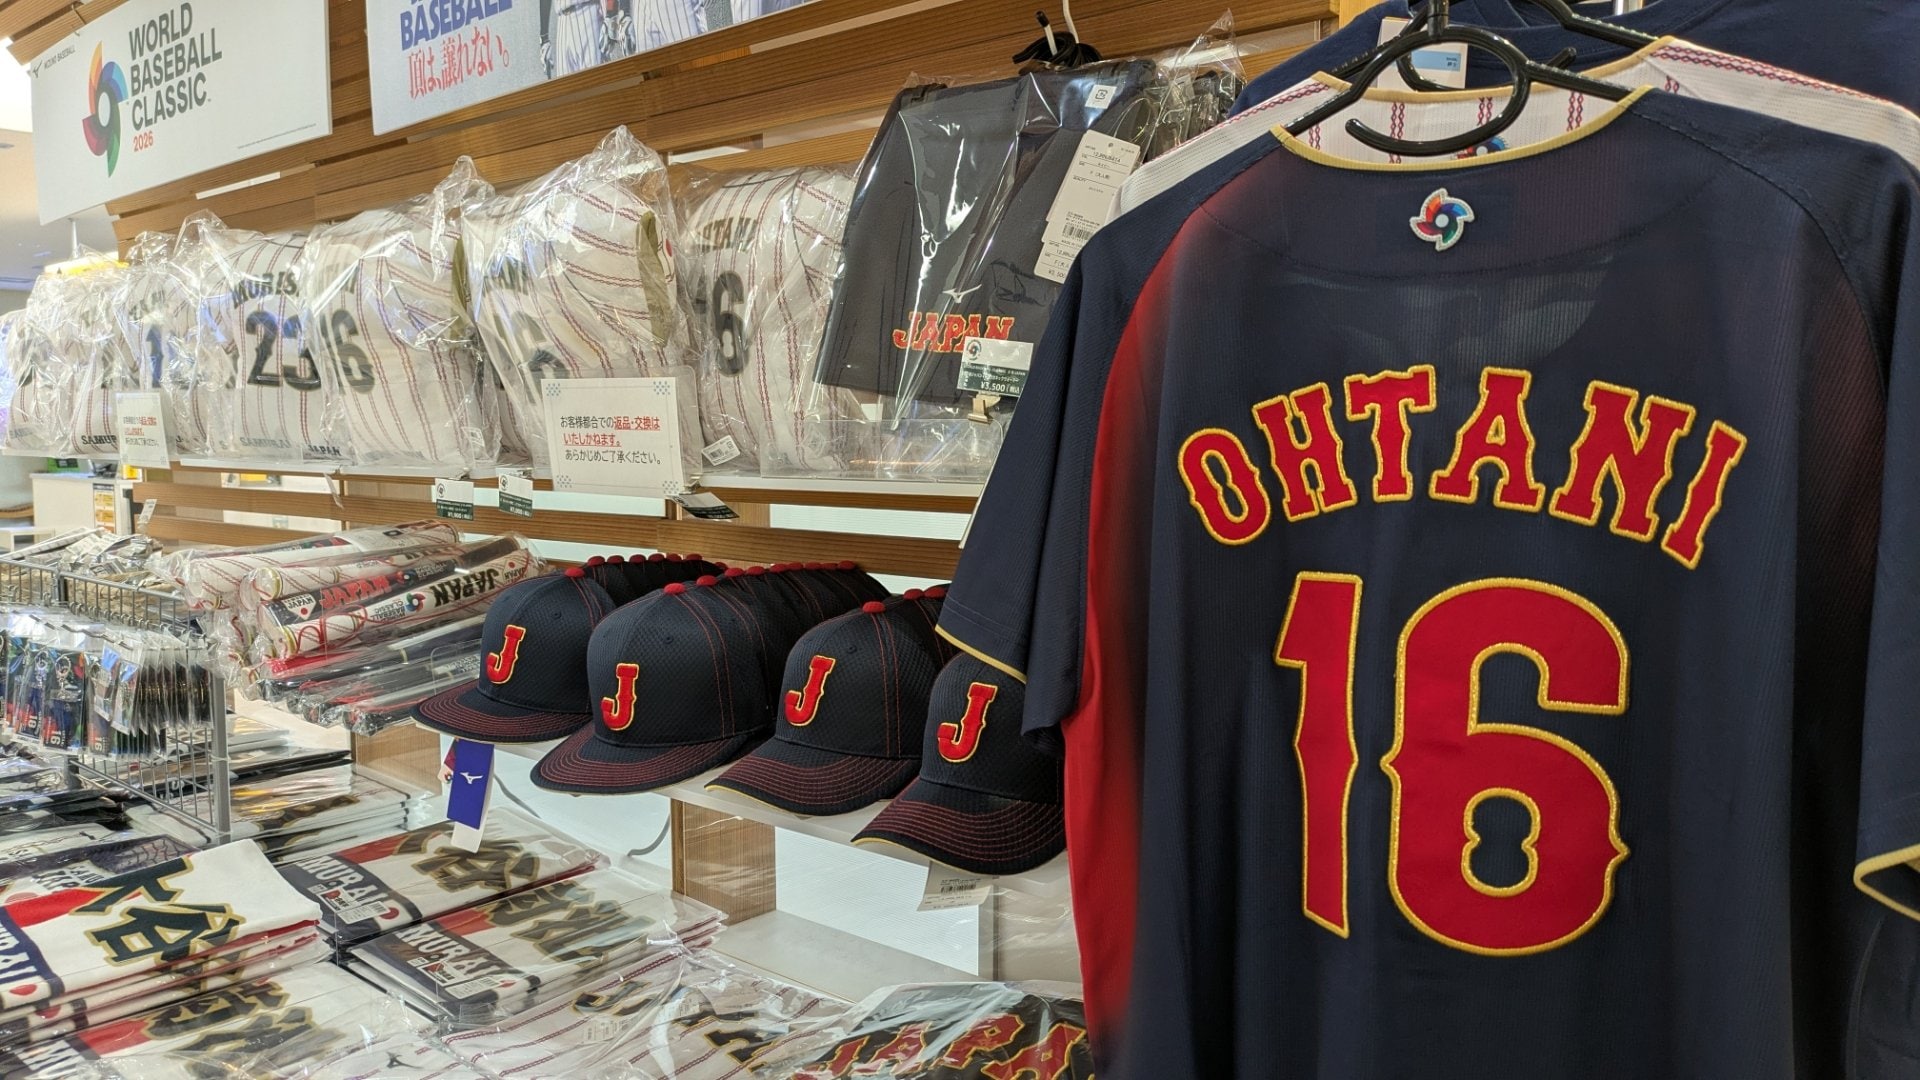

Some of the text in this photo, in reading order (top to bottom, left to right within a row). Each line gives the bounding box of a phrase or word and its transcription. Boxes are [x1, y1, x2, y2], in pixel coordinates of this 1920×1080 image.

[129, 2, 193, 61] WORLD
[130, 27, 222, 97] BASEBALL
[132, 71, 207, 131] CLASSIC
[134, 130, 154, 152] 2026
[246, 309, 322, 392] 23
[893, 312, 1015, 354] JAPAN
[560, 416, 660, 430] お客様都合での返品・交換は
[563, 433, 620, 447] いたしかねます。
[565, 449, 660, 464] あらかじめご了承ください。
[1177, 364, 1747, 569] OHTANI
[287, 596, 314, 609] JAPAN
[320, 575, 391, 609] JAPAN
[429, 568, 499, 607] JAPAN
[486, 623, 526, 684] J
[601, 662, 639, 731] J
[784, 654, 836, 727] J
[937, 681, 997, 762] J
[1273, 571, 1630, 957] 16
